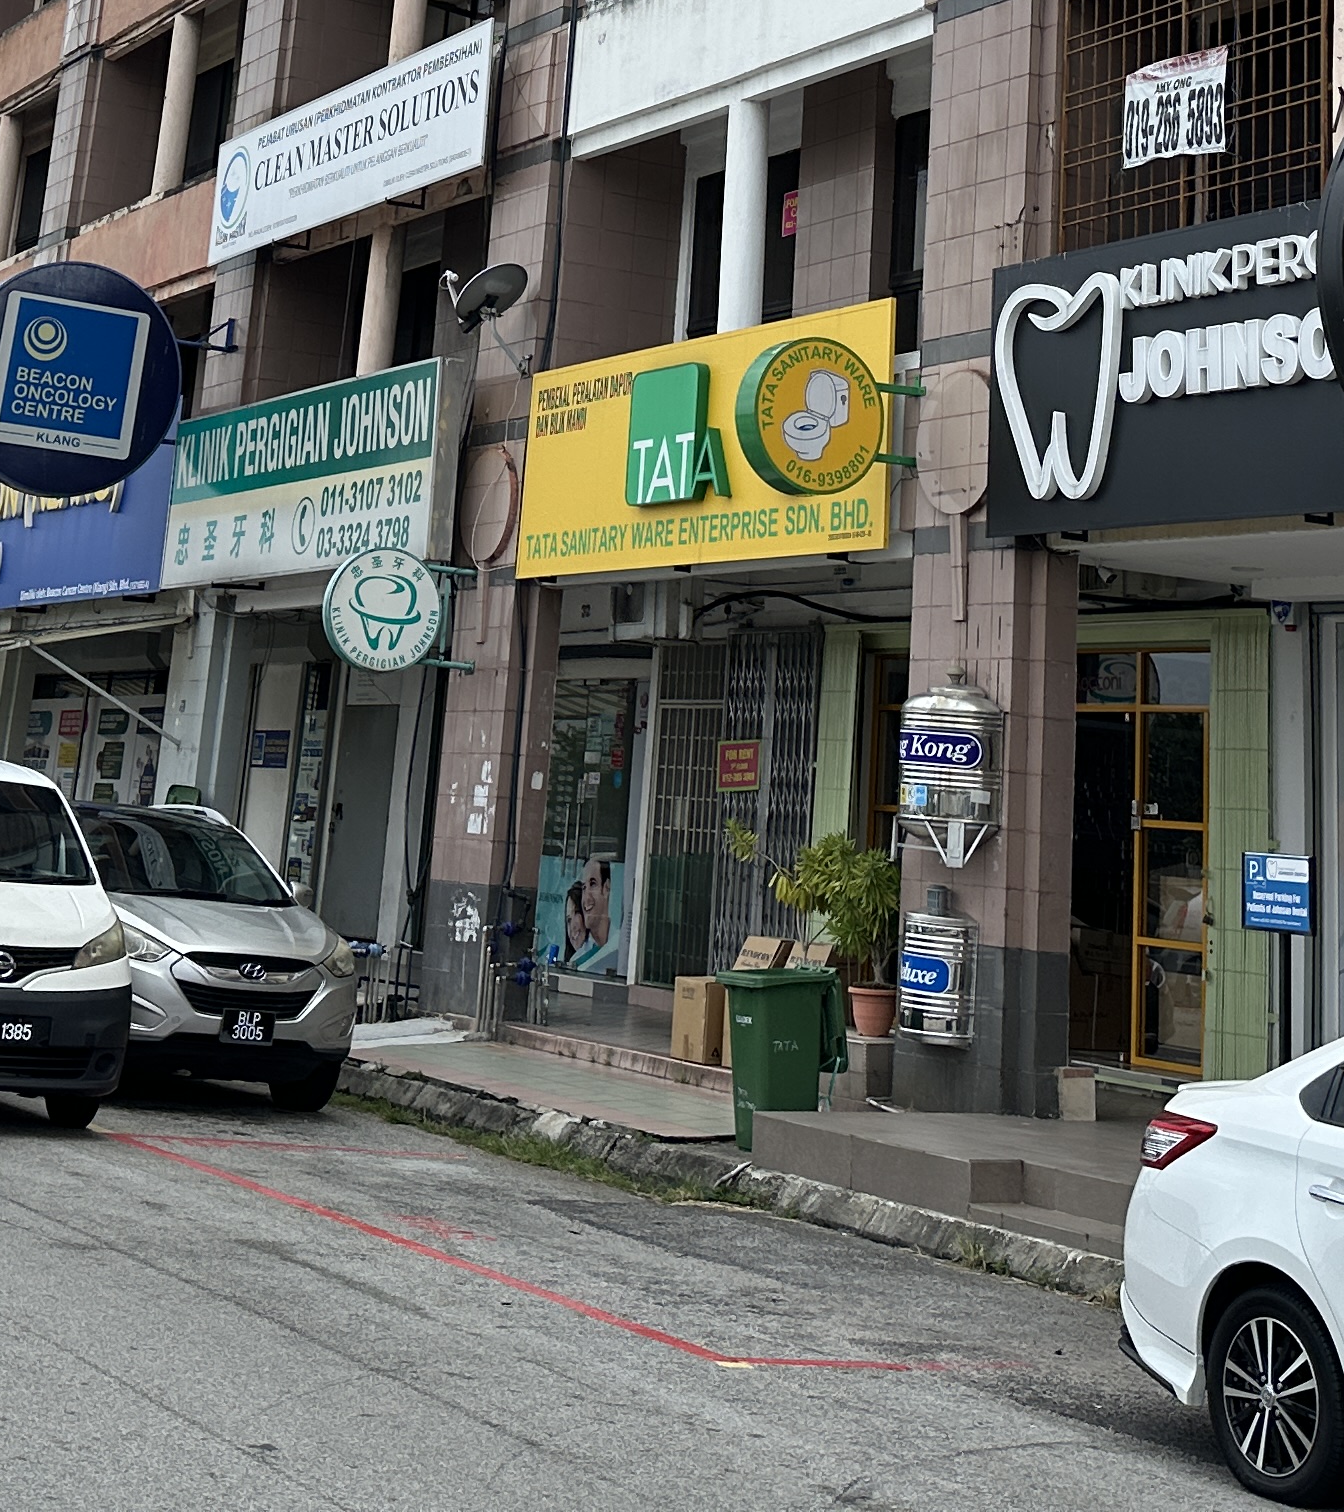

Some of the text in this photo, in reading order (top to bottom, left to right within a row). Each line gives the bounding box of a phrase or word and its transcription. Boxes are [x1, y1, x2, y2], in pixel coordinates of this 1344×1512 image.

[257, 126, 284, 151] PEJABAT
[371, 65, 422, 100] KONTRAKTOR
[422, 38, 483, 77] PEMBERSIHAN)
[1154, 75, 1193, 95] AMY ONG
[254, 144, 305, 191] CLEAN
[305, 114, 375, 165] MASTER
[377, 69, 480, 141] SOLUTIONS
[1124, 82, 1224, 160] 019-266 5893
[1120, 247, 1233, 310] KLINIK
[13, 383, 117, 412] ONCOLOGY
[16, 366, 93, 391] BEACON
[761, 345, 876, 431] TATA SANITARY WARE
[11, 400, 86, 424] CENTRE
[177, 377, 432, 489] KLINIK PERGIGIAN JOHNSON
[35, 431, 81, 448] KLANG
[632, 426, 732, 505] TATA
[785, 444, 870, 487] 016-9398801
[320, 469, 423, 517] 011-3107 3102
[174, 508, 275, 566] 忠圣牙科
[316, 515, 410, 559] 03-3324 3798
[525, 498, 874, 561] TATA SANITARY WARE ENTERPRISE SDN. BHD.
[350, 555, 426, 583] 忠圣牙科
[331, 606, 439, 669] KLINIK PERGIGIAN JOHNSON
[910, 734, 972, 763] Kong
[1249, 860, 1259, 880] P
[1, 1022, 33, 1041] 1385
[231, 1025, 264, 1041] 3005
[237, 1010, 262, 1026] BLP
